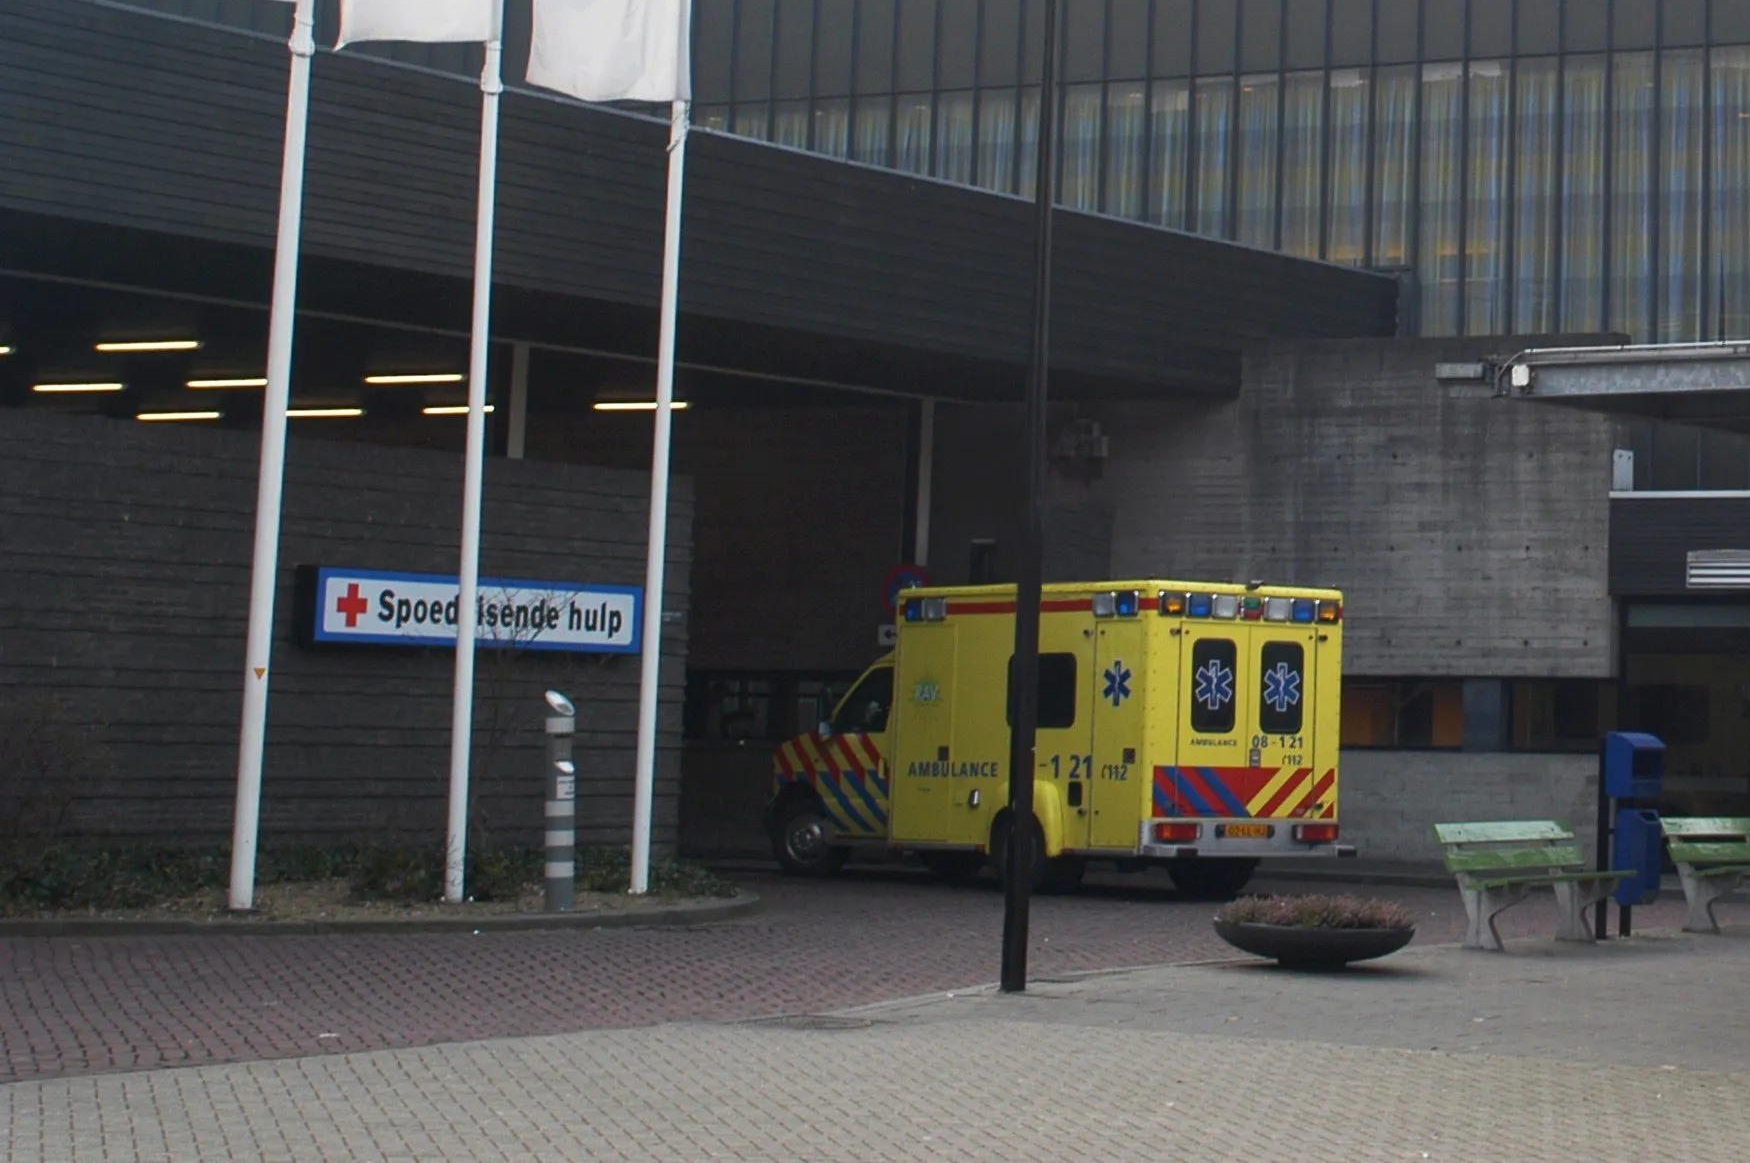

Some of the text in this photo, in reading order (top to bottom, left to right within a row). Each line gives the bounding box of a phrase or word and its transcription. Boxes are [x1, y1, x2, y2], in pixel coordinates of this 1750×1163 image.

[377, 589, 622, 638] Spoedisende hulp
[908, 761, 998, 778] AMBULANCE
